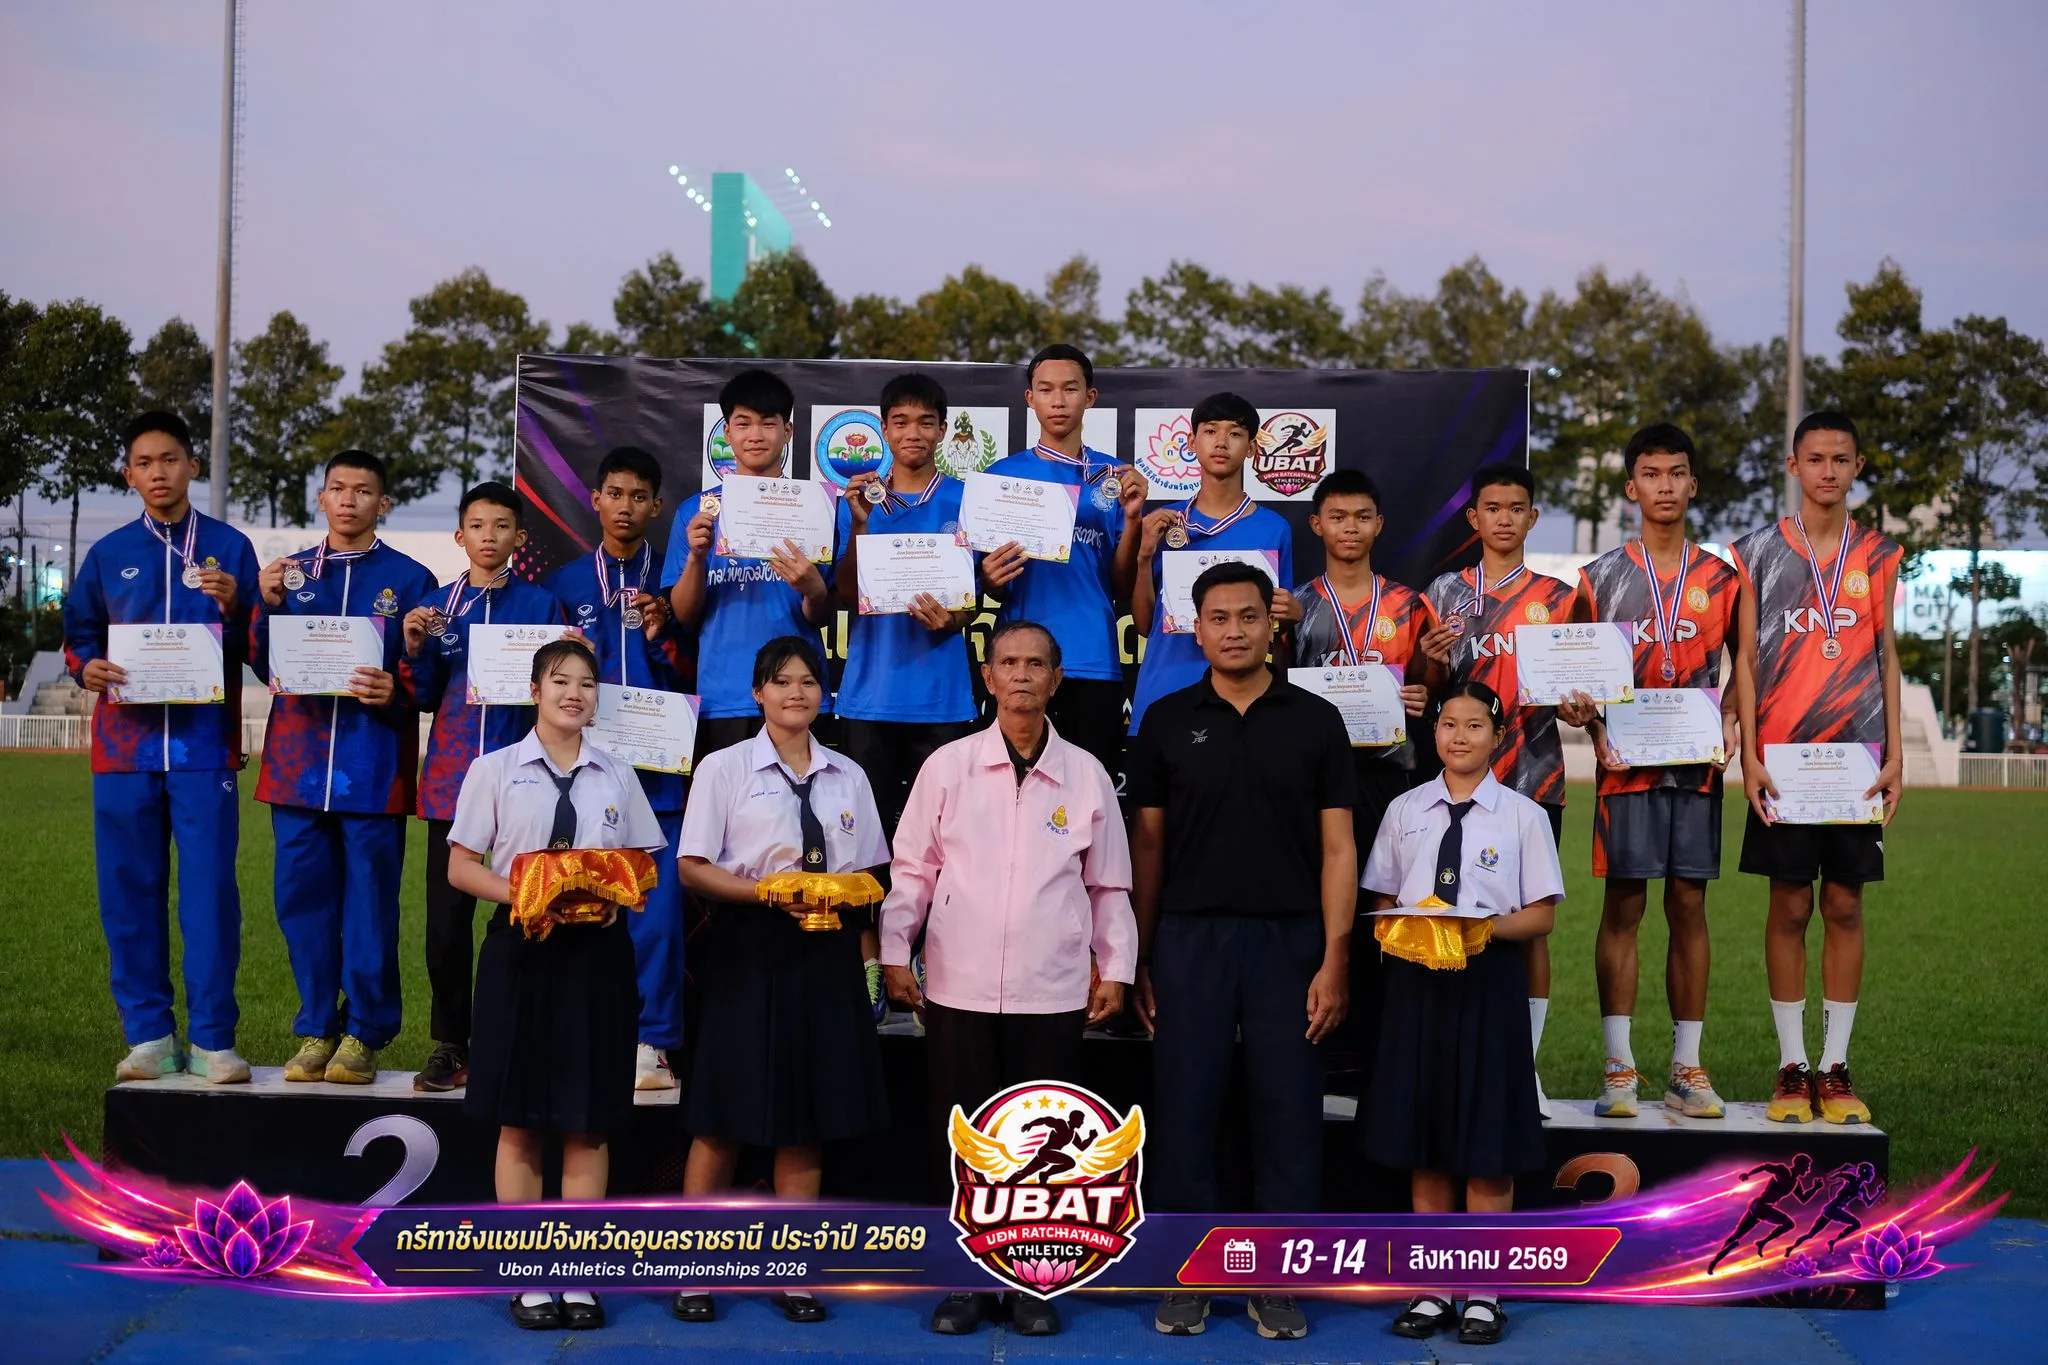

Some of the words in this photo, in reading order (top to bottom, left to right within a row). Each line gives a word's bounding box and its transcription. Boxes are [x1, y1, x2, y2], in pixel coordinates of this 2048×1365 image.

[1135, 457, 1201, 491] มูลนิธิกีฬาจังหวัดอุบ
[1258, 455, 1321, 471] UBAT
[1783, 607, 1858, 634] KNP
[1470, 631, 1516, 660] KN
